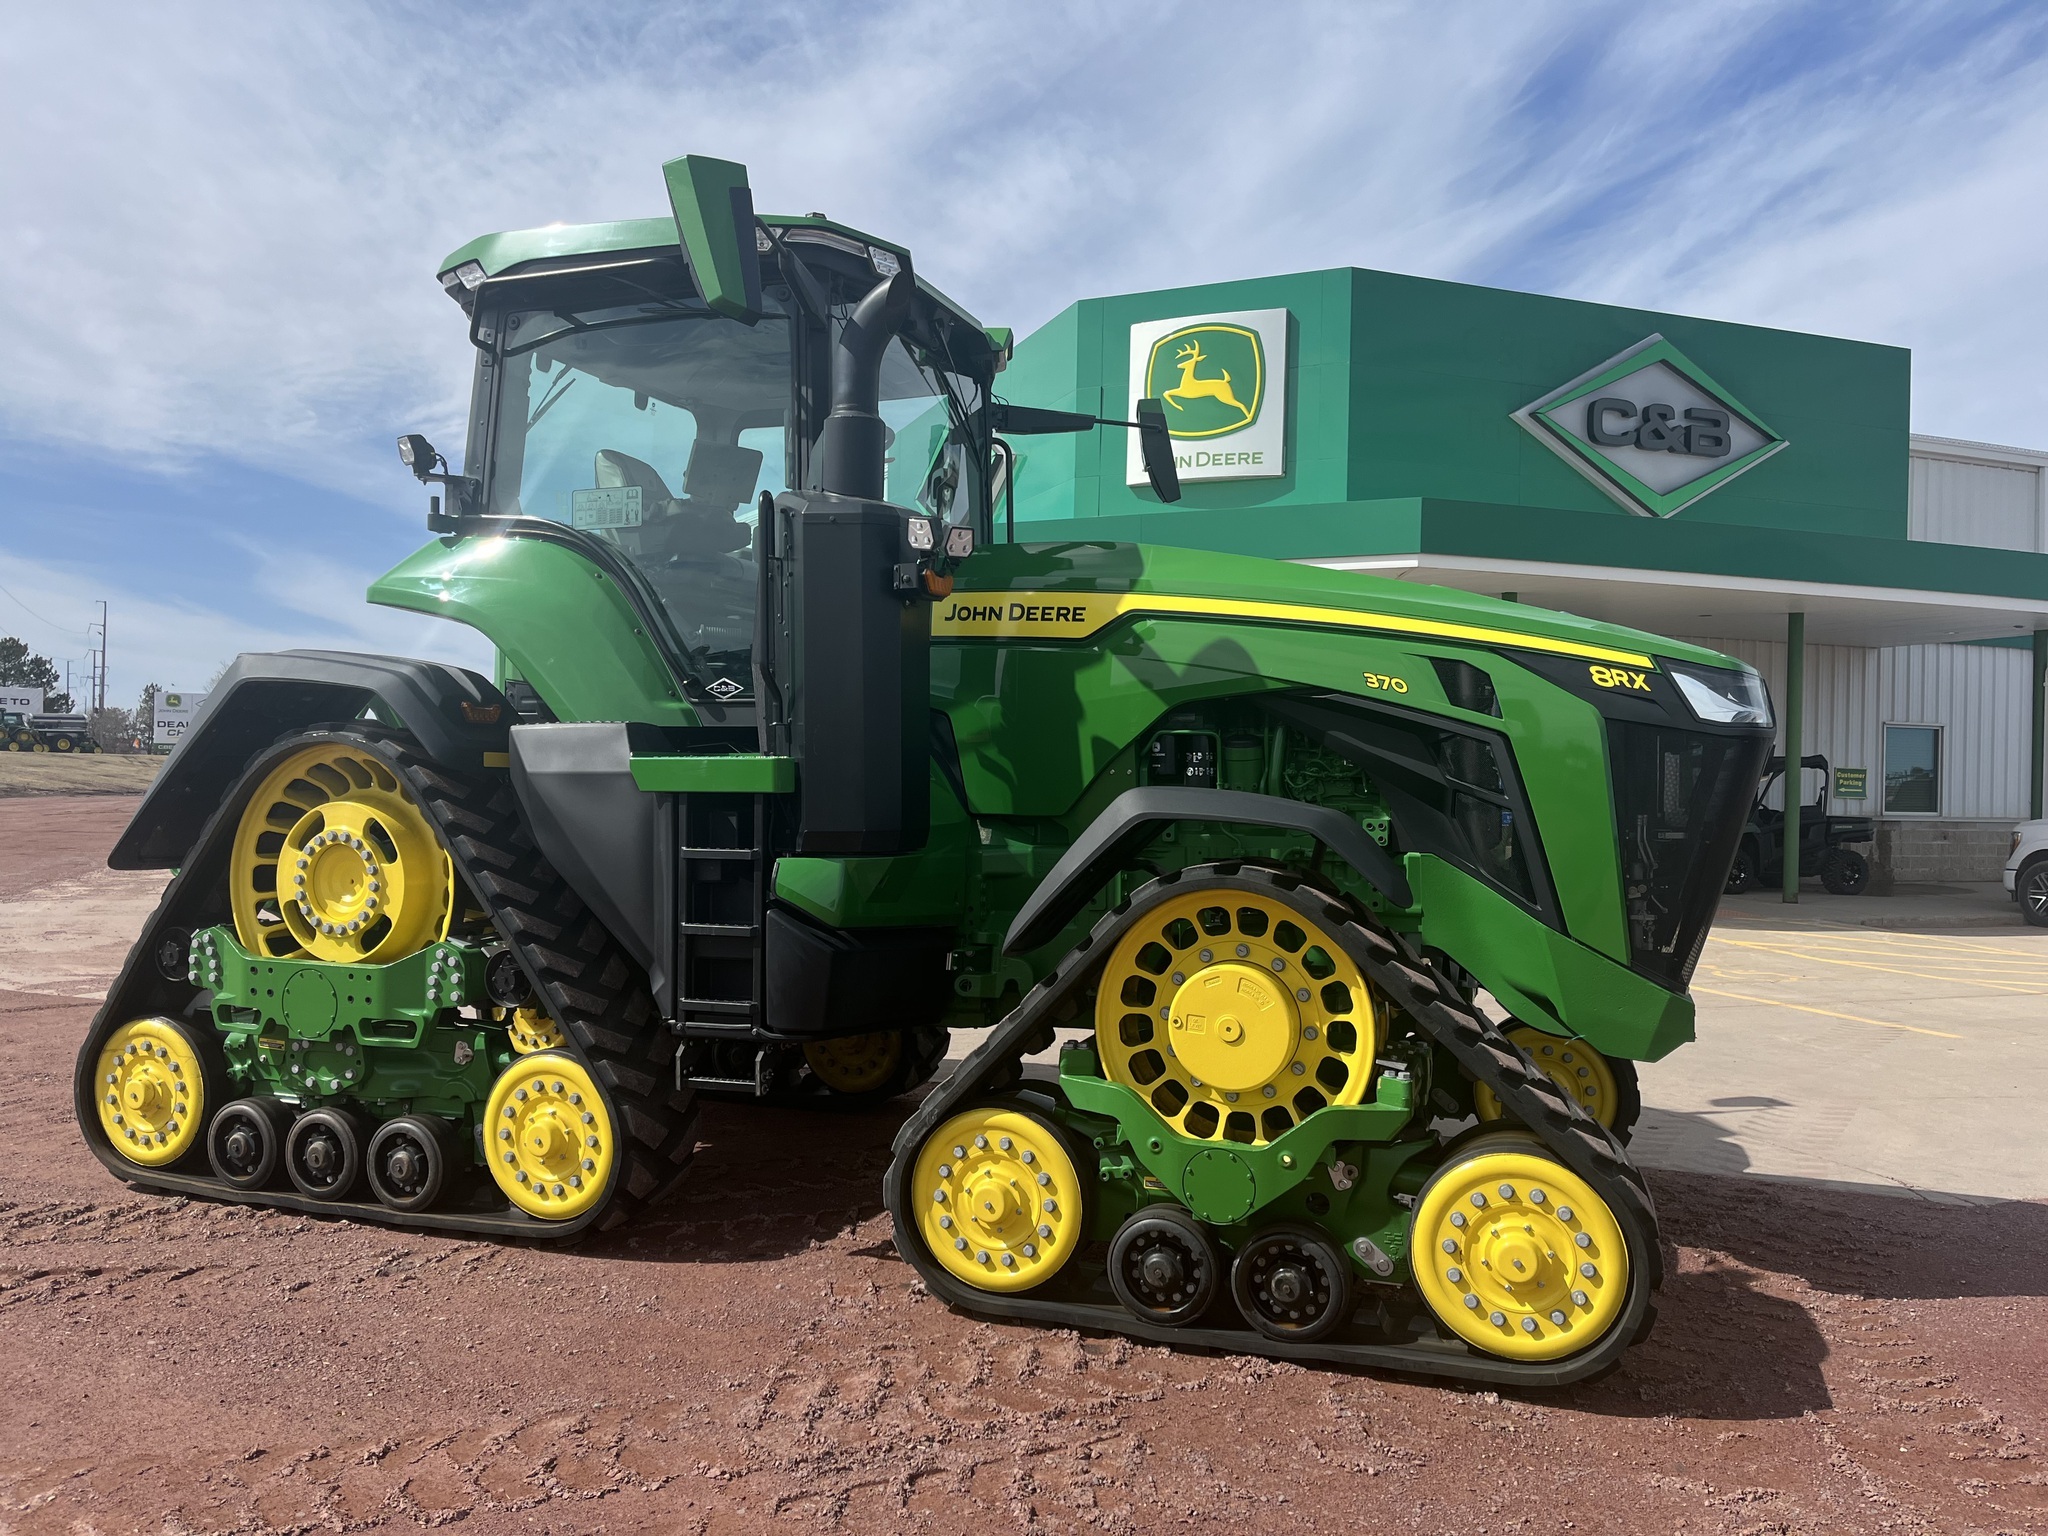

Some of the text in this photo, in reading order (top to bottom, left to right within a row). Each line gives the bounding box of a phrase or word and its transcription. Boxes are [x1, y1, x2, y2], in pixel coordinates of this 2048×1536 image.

[1587, 397, 1732, 458] C&B
[1195, 451, 1264, 468] DEERE
[944, 602, 1087, 623] JOHN DEERE
[1362, 671, 1409, 695] 370
[1588, 665, 1652, 692] 8RX
[10, 697, 30, 706] TO
[1836, 771, 1865, 779] Customer
